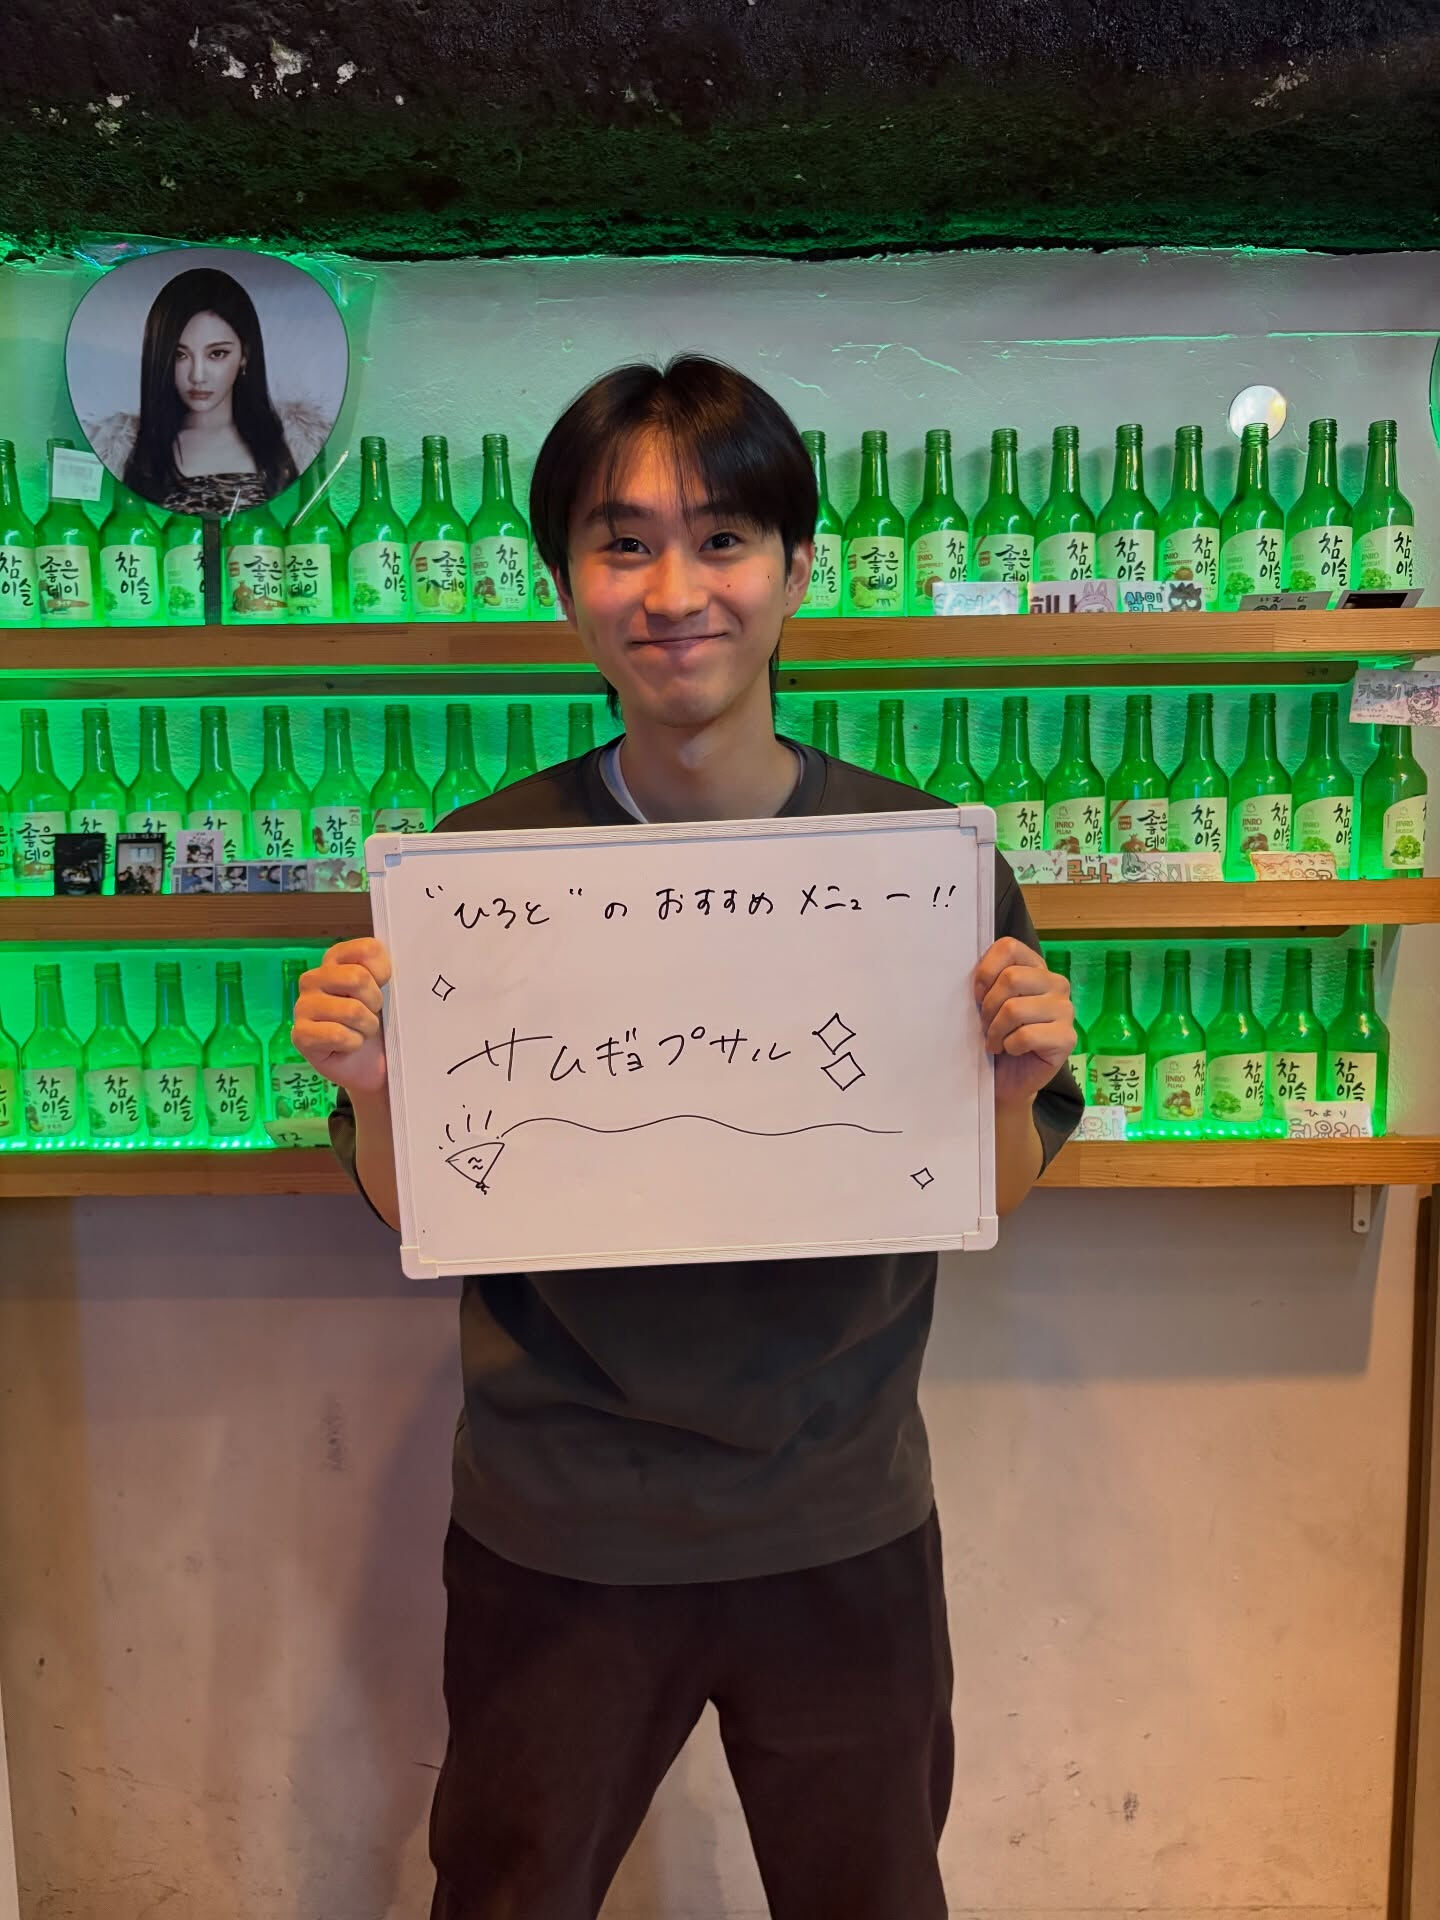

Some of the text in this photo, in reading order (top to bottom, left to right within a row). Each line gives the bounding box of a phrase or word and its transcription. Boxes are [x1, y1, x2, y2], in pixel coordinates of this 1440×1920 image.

[496, 544, 519, 571] 참
[946, 537, 965, 565] 참
[995, 544, 1031, 571] 좋은
[1067, 538, 1089, 566] 참
[1114, 536, 1140, 563] 참
[1192, 533, 1213, 560] 참
[1256, 535, 1279, 562] 참
[1318, 532, 1343, 560] 참
[1394, 531, 1412, 559] 참
[40, 556, 79, 583] 좋은
[115, 551, 142, 578] 참
[244, 555, 283, 581] 좋은
[287, 555, 319, 581] 좋은
[379, 547, 402, 575] 참
[432, 551, 467, 576] 좋은
[861, 546, 899, 574] 좋은
[1195, 558, 1217, 585] 이슬
[1321, 558, 1348, 587] 이슬
[500, 569, 526, 597] 이슬
[811, 565, 838, 594] 이슬
[868, 573, 899, 592] 데이
[1260, 561, 1281, 590] 이슬
[1, 577, 35, 607] 이슬
[47, 581, 79, 598] 데이
[120, 577, 153, 605] 이슬
[253, 582, 283, 598] 데이
[290, 580, 318, 598] 데이
[326, 815, 348, 840] 참
[1017, 807, 1038, 837] 참
[1083, 805, 1102, 829] 참
[1137, 809, 1167, 835] 좋은
[1192, 804, 1215, 830] 참
[1241, 817, 1262, 827] JINRO
[1271, 802, 1289, 827] 참
[1333, 802, 1352, 829] 참
[16, 823, 55, 846] 좋은
[262, 815, 285, 841] 참
[447, 1026, 791, 1082] サムギョプサル
[1102, 1065, 1140, 1090] 좋은
[1165, 1073, 1186, 1083] JINRO
[1243, 1059, 1263, 1083] 참
[1276, 1057, 1300, 1083] 참
[1335, 1057, 1359, 1083] 참
[37, 1075, 61, 1098] 참
[104, 1074, 129, 1098] 참
[159, 1074, 183, 1098] 참
[216, 1073, 240, 1098] 참
[284, 1073, 323, 1097] 좋은
[1109, 1089, 1139, 1105] 데이
[42, 1095, 72, 1121] 이슬
[109, 1095, 139, 1122] 이슬
[163, 1095, 194, 1122] 이슬
[220, 1095, 251, 1122] 이슬
[293, 1095, 322, 1111] 데이
[1304, 1109, 1347, 1118] ひより
